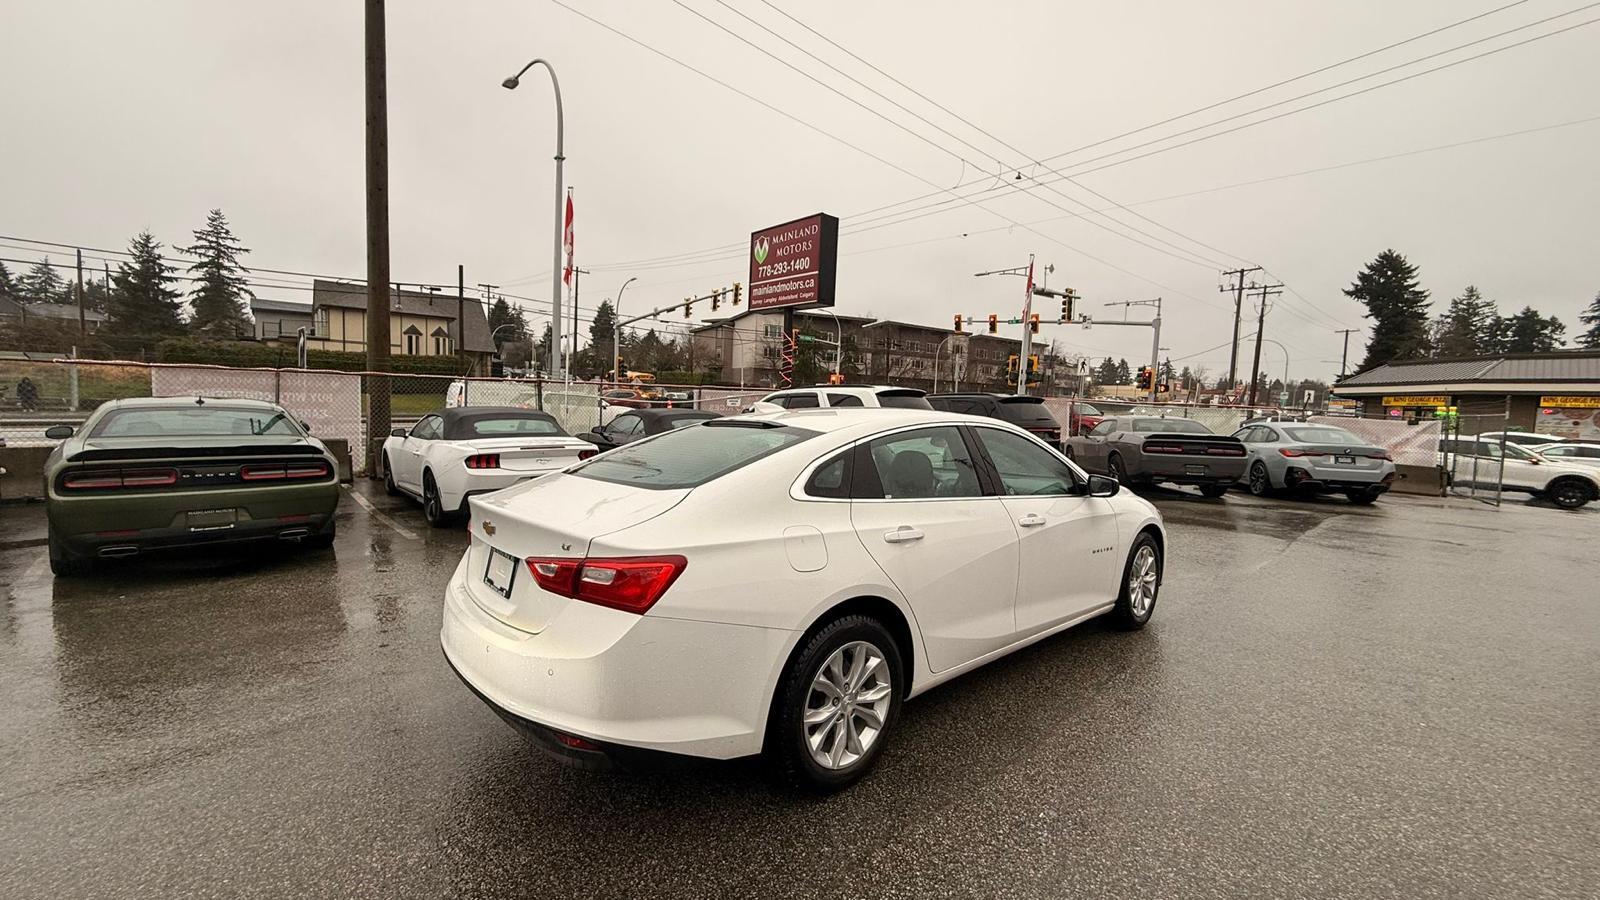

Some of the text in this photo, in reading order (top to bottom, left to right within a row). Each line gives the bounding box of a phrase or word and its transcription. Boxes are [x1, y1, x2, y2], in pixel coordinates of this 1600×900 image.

[771, 224, 819, 245] MAINLAND
[776, 240, 813, 257] MOTORS
[758, 257, 810, 278] 778-293-1400
[752, 278, 815, 296] mainlandmotors.ca
